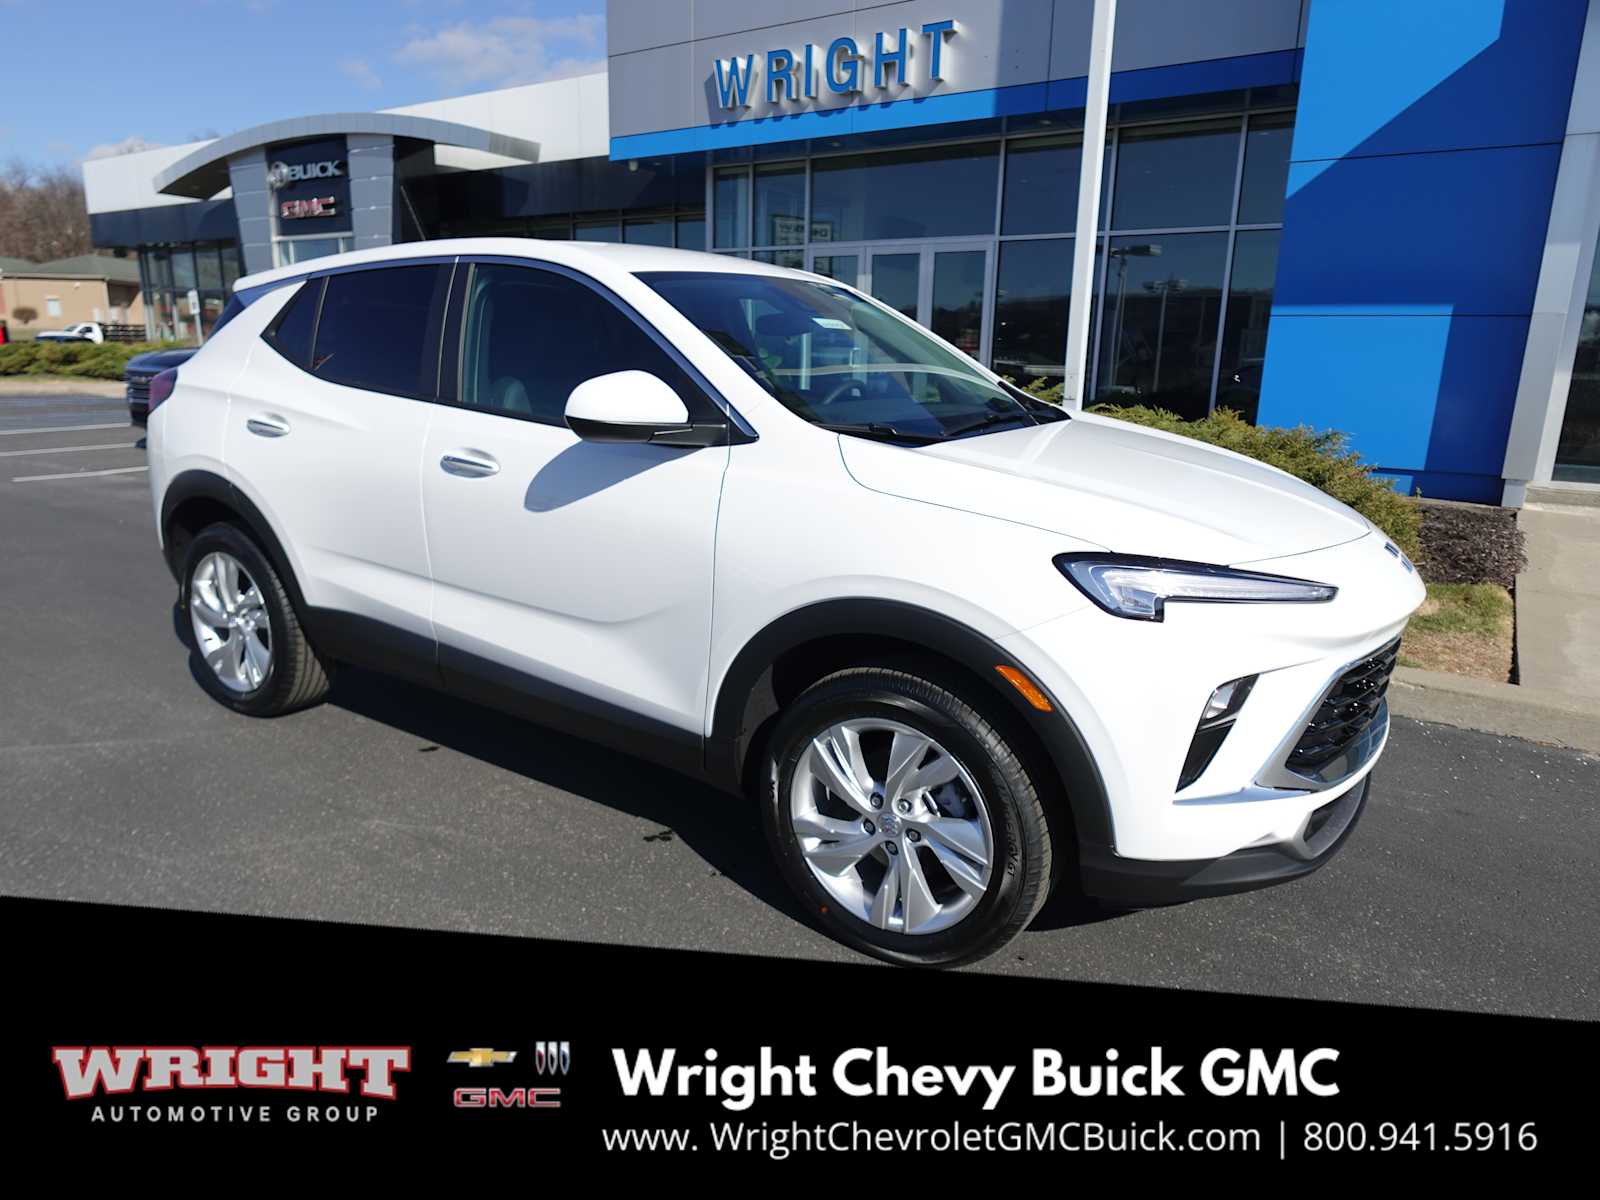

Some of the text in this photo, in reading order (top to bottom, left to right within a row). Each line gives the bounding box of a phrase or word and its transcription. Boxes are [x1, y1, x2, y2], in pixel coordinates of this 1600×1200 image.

[714, 19, 957, 109] WRIGHT
[287, 160, 342, 181] BUICK
[281, 196, 336, 219] GMC
